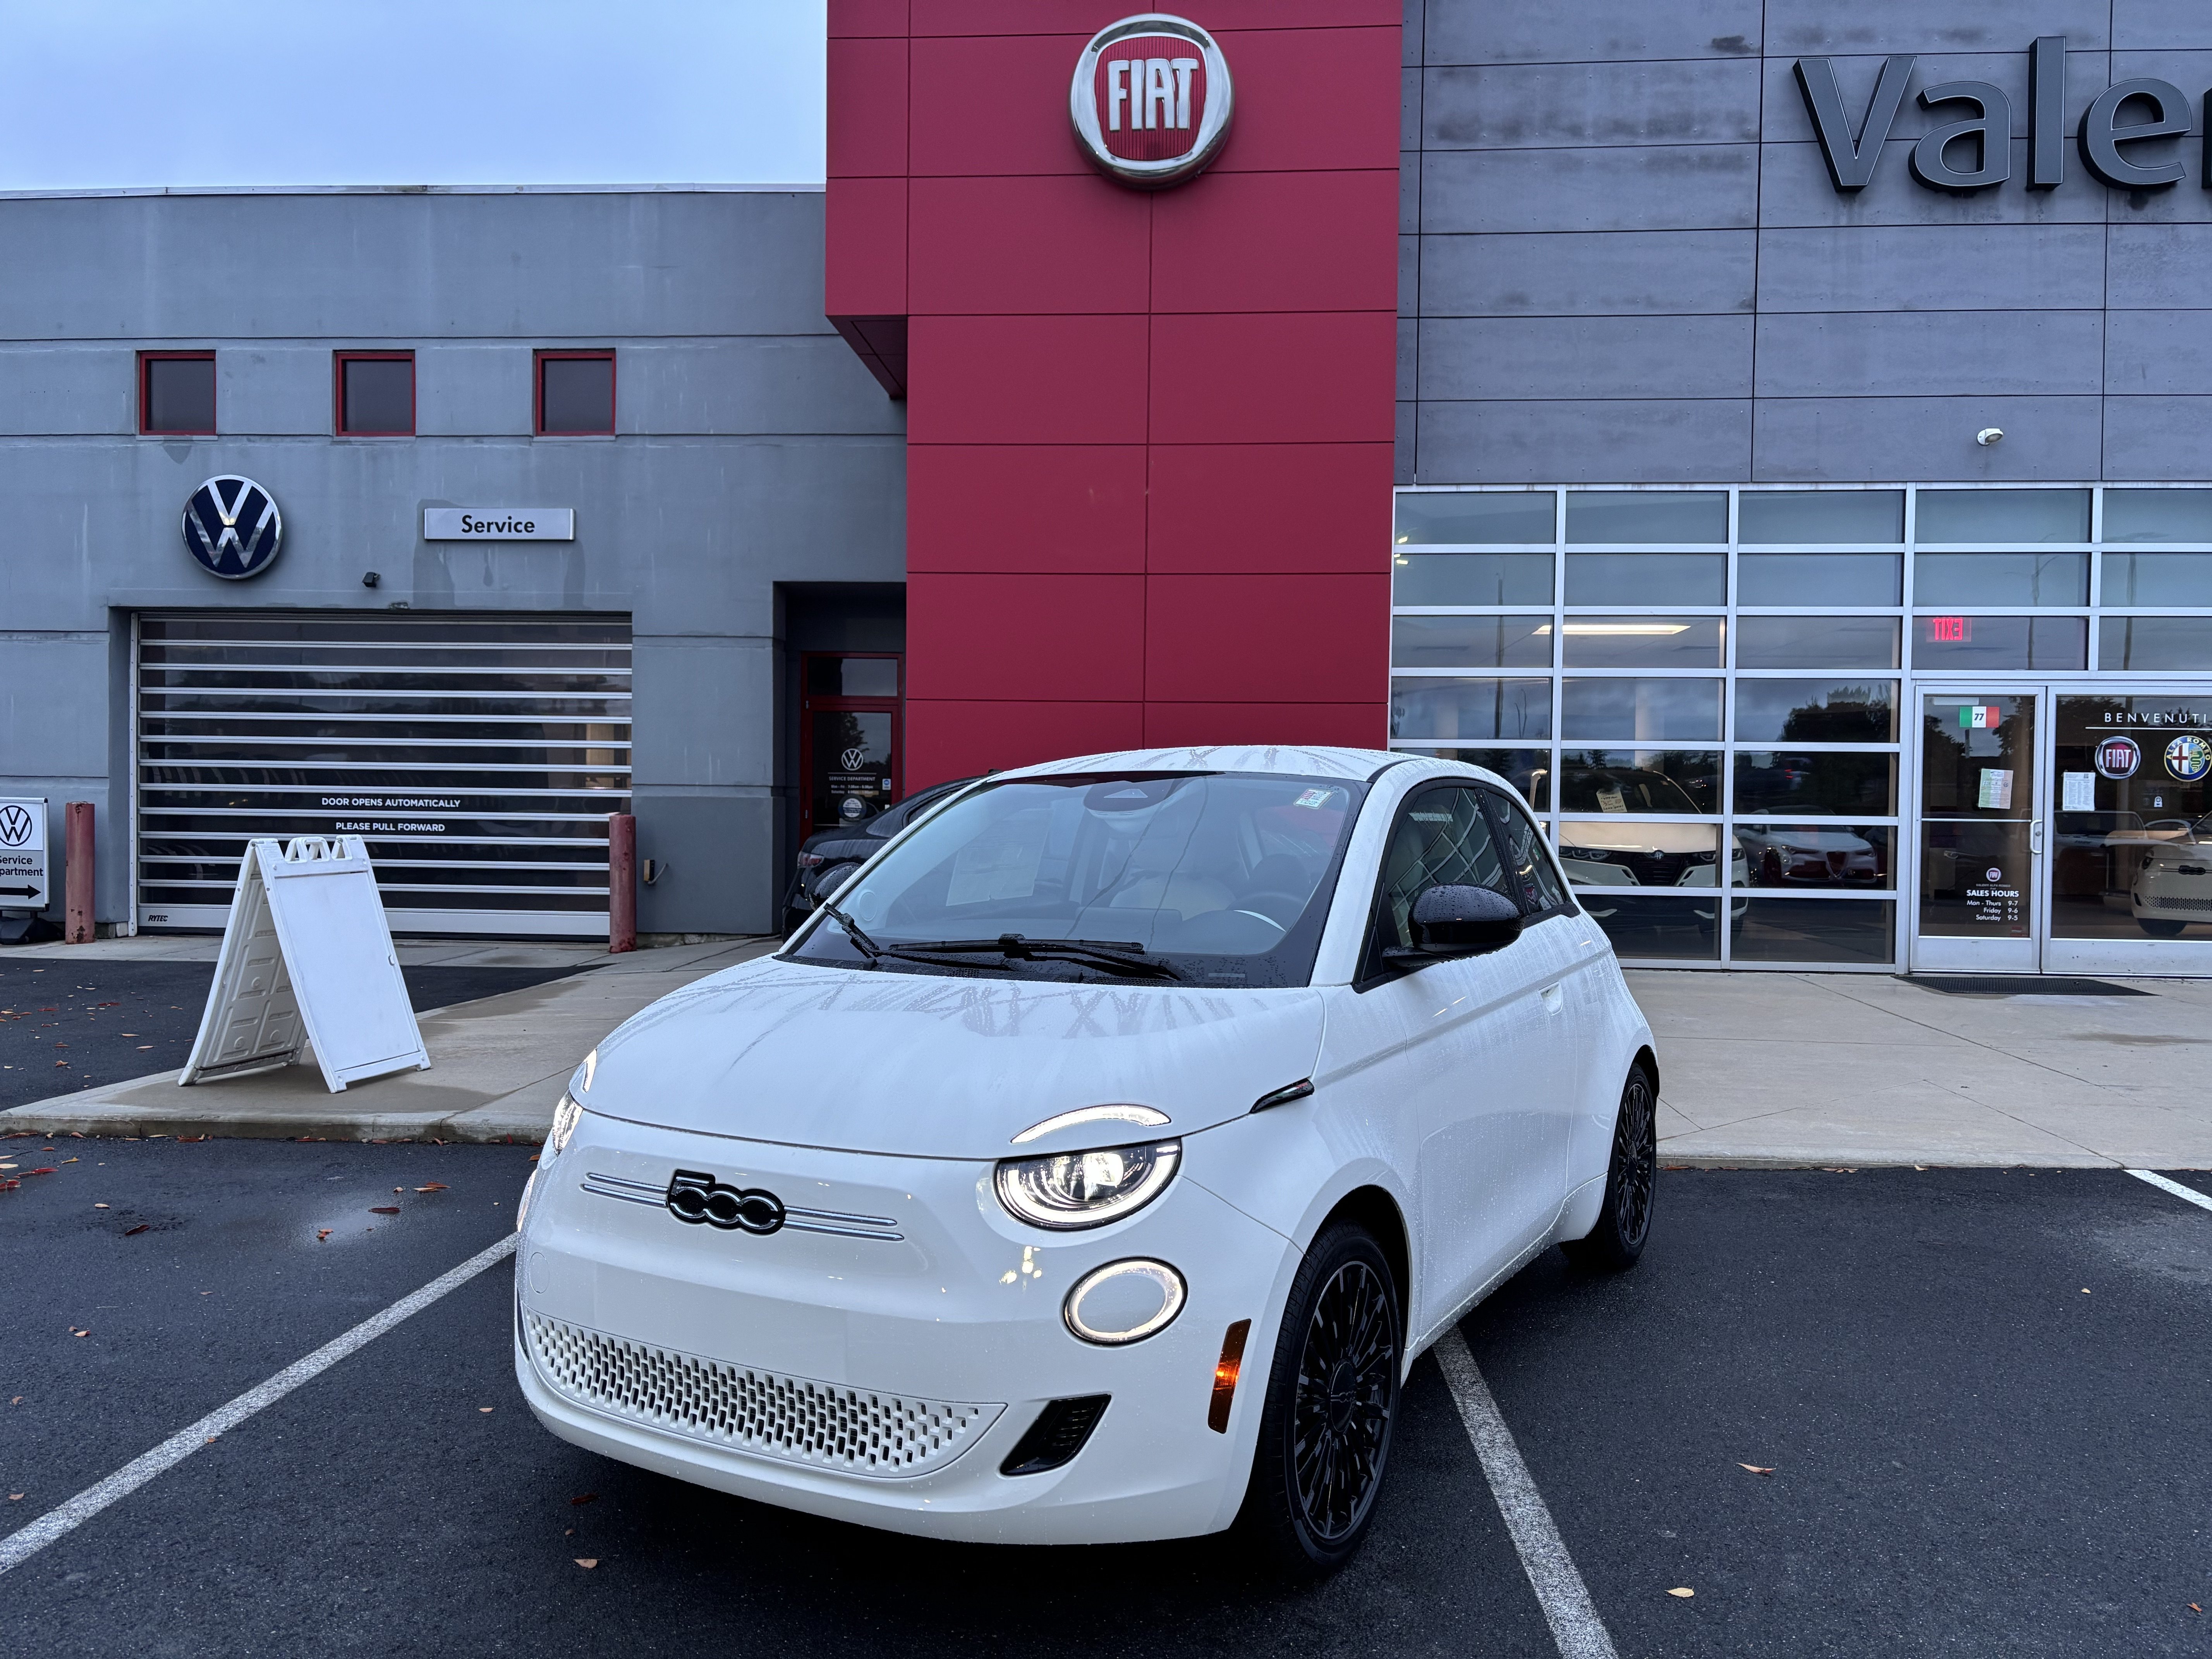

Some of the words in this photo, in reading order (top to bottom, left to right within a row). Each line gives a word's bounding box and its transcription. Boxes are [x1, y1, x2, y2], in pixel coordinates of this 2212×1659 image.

[1107, 58, 1199, 132] FIAT
[1793, 36, 2212, 192] Vale
[461, 515, 535, 533] Service
[2105, 713, 2206, 723] BENVENUTI
[2106, 749, 2131, 768] FIAT
[2166, 740, 2183, 760] ALFA
[2187, 737, 2211, 761] ROMEO
[322, 797, 349, 805] DOOR
[352, 798, 383, 806] OPENS
[385, 799, 460, 807] AUTOMATICALLY
[336, 822, 370, 830] PLEASE
[398, 823, 445, 831] FORWARD
[668, 1170, 785, 1235] 500
